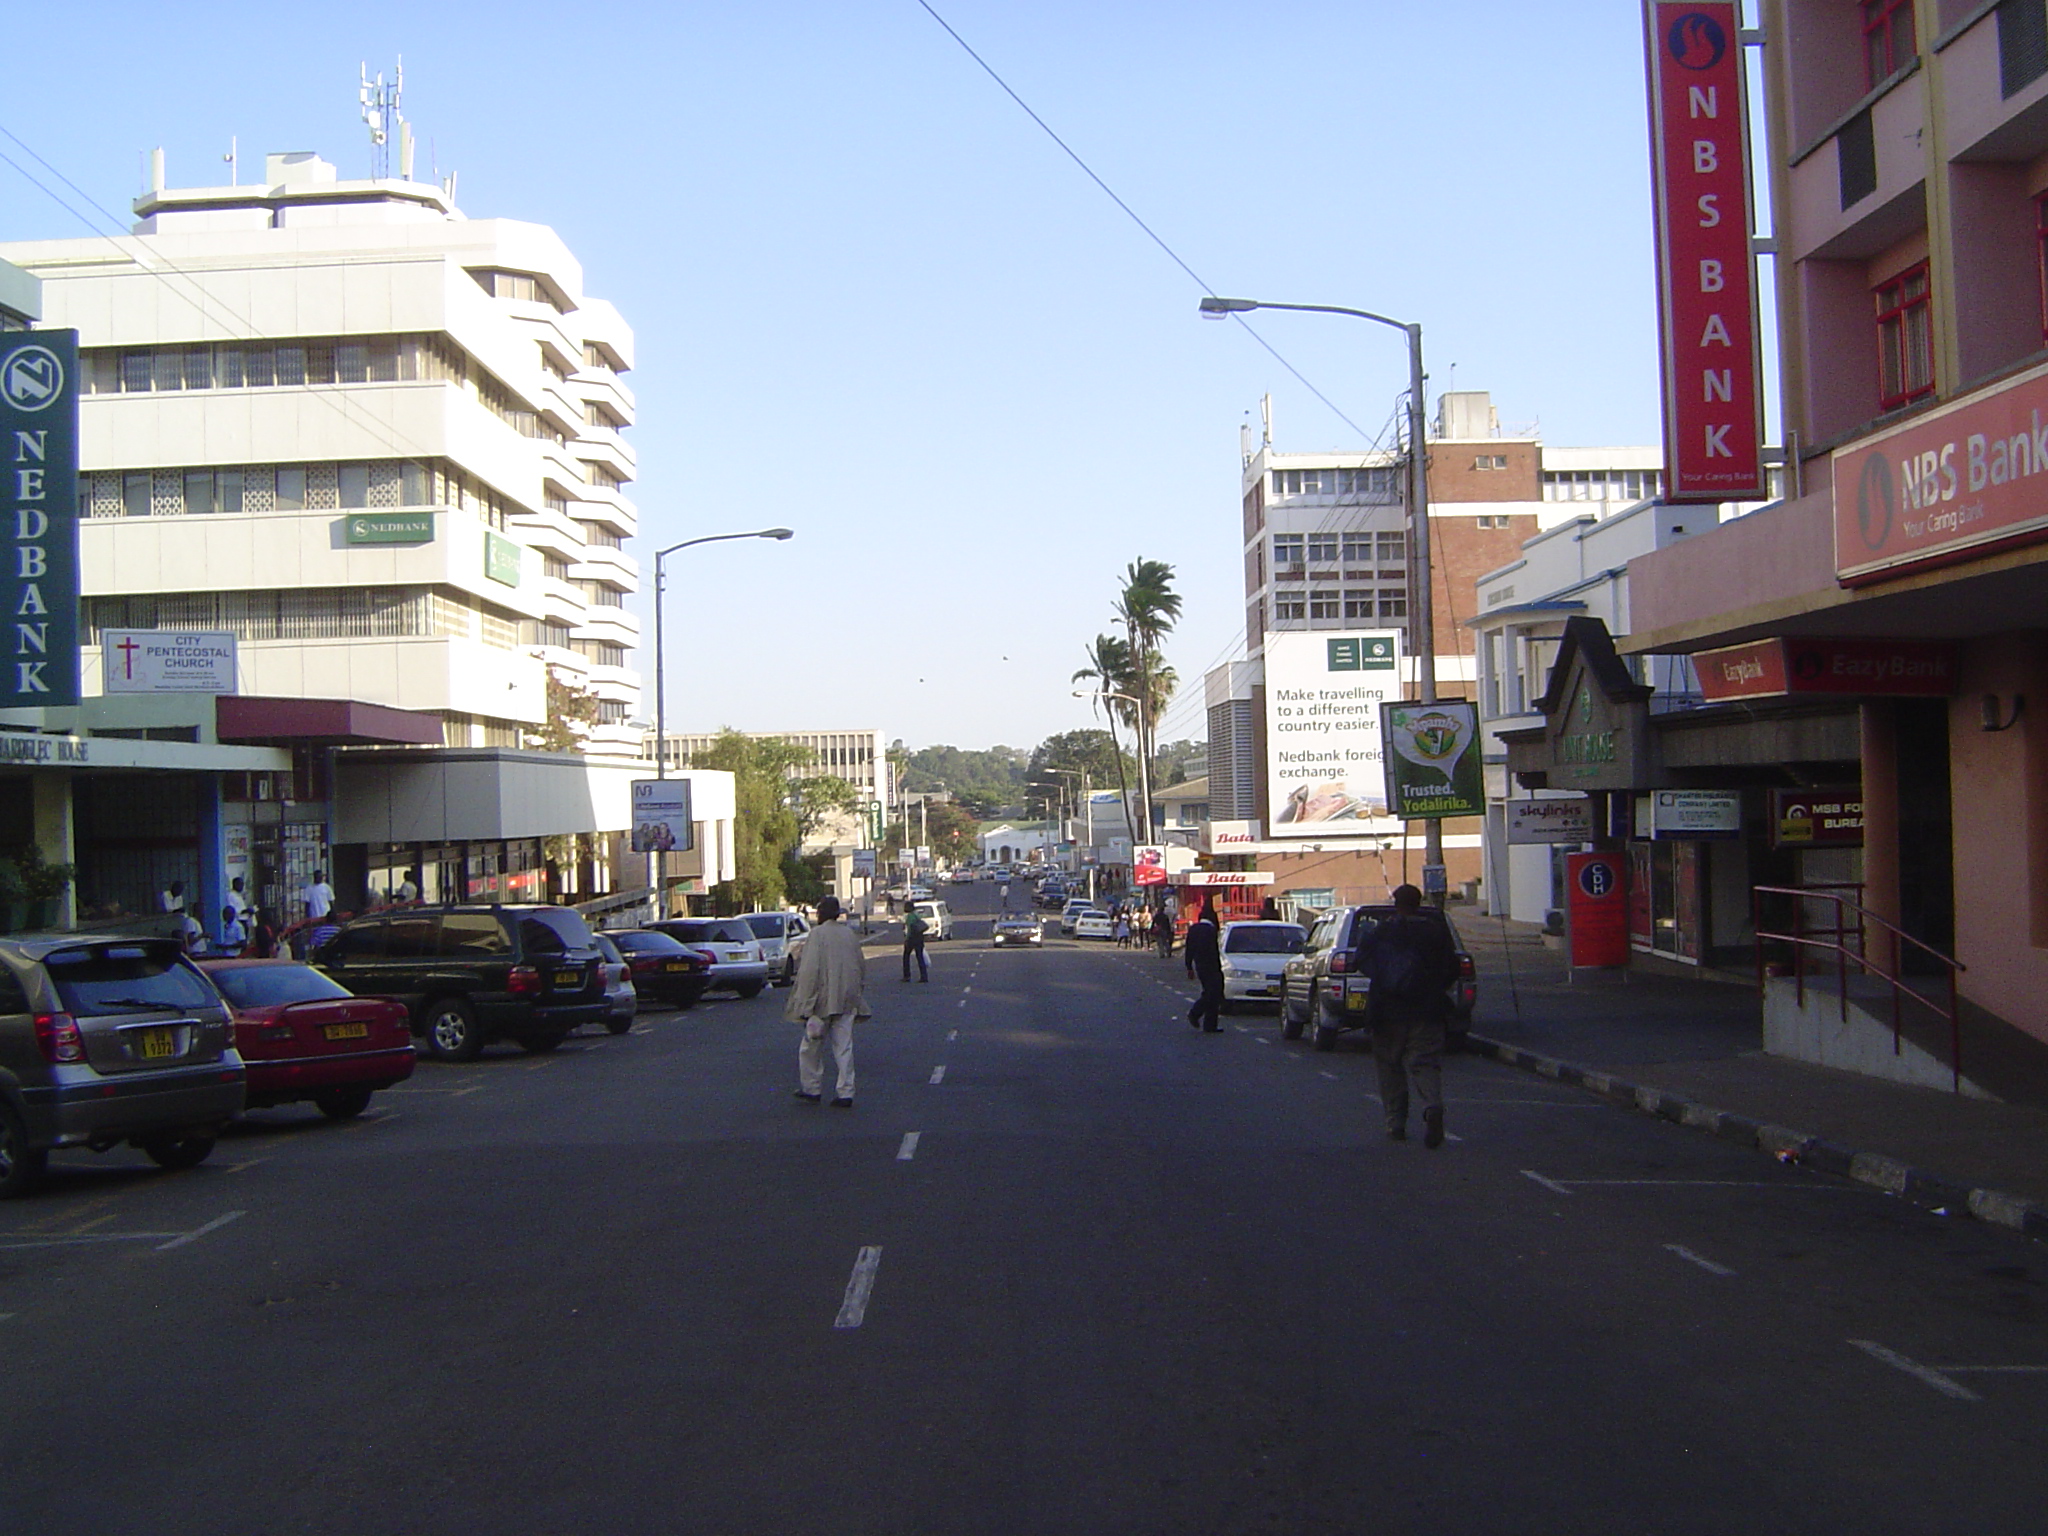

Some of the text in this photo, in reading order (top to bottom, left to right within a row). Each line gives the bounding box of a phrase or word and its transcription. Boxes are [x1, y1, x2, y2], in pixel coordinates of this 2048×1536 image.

[1688, 86, 1733, 458] NBS BANK
[1901, 408, 2048, 512] NBS Bank
[1681, 471, 1756, 483] Your Caring Bank
[1902, 499, 1984, 538] Your Caring Bank
[371, 522, 429, 532] NEDBANK
[15, 429, 50, 693] NEDBANK
[175, 636, 201, 646] CITY
[146, 646, 230, 658] PENTECOSTAL
[165, 658, 214, 668] CHURCH
[1723, 656, 1764, 684] EazyBank
[1832, 654, 1949, 680] EazyBank
[1277, 687, 1384, 702] Make travelling
[1277, 703, 1370, 717] to a different
[1277, 720, 1331, 734] country
[1335, 718, 1379, 731] easier.
[1278, 750, 1341, 763] Nedbank
[1279, 765, 1349, 780] exchange.
[1401, 781, 1456, 798] Trusted.
[1402, 797, 1472, 813] Yodalirika.
[1519, 803, 1582, 819] skylinks
[1812, 804, 1841, 814] MSB
[1216, 833, 1255, 844] Bata
[1205, 873, 1246, 884] Bata
[1591, 864, 1604, 894] CDH
